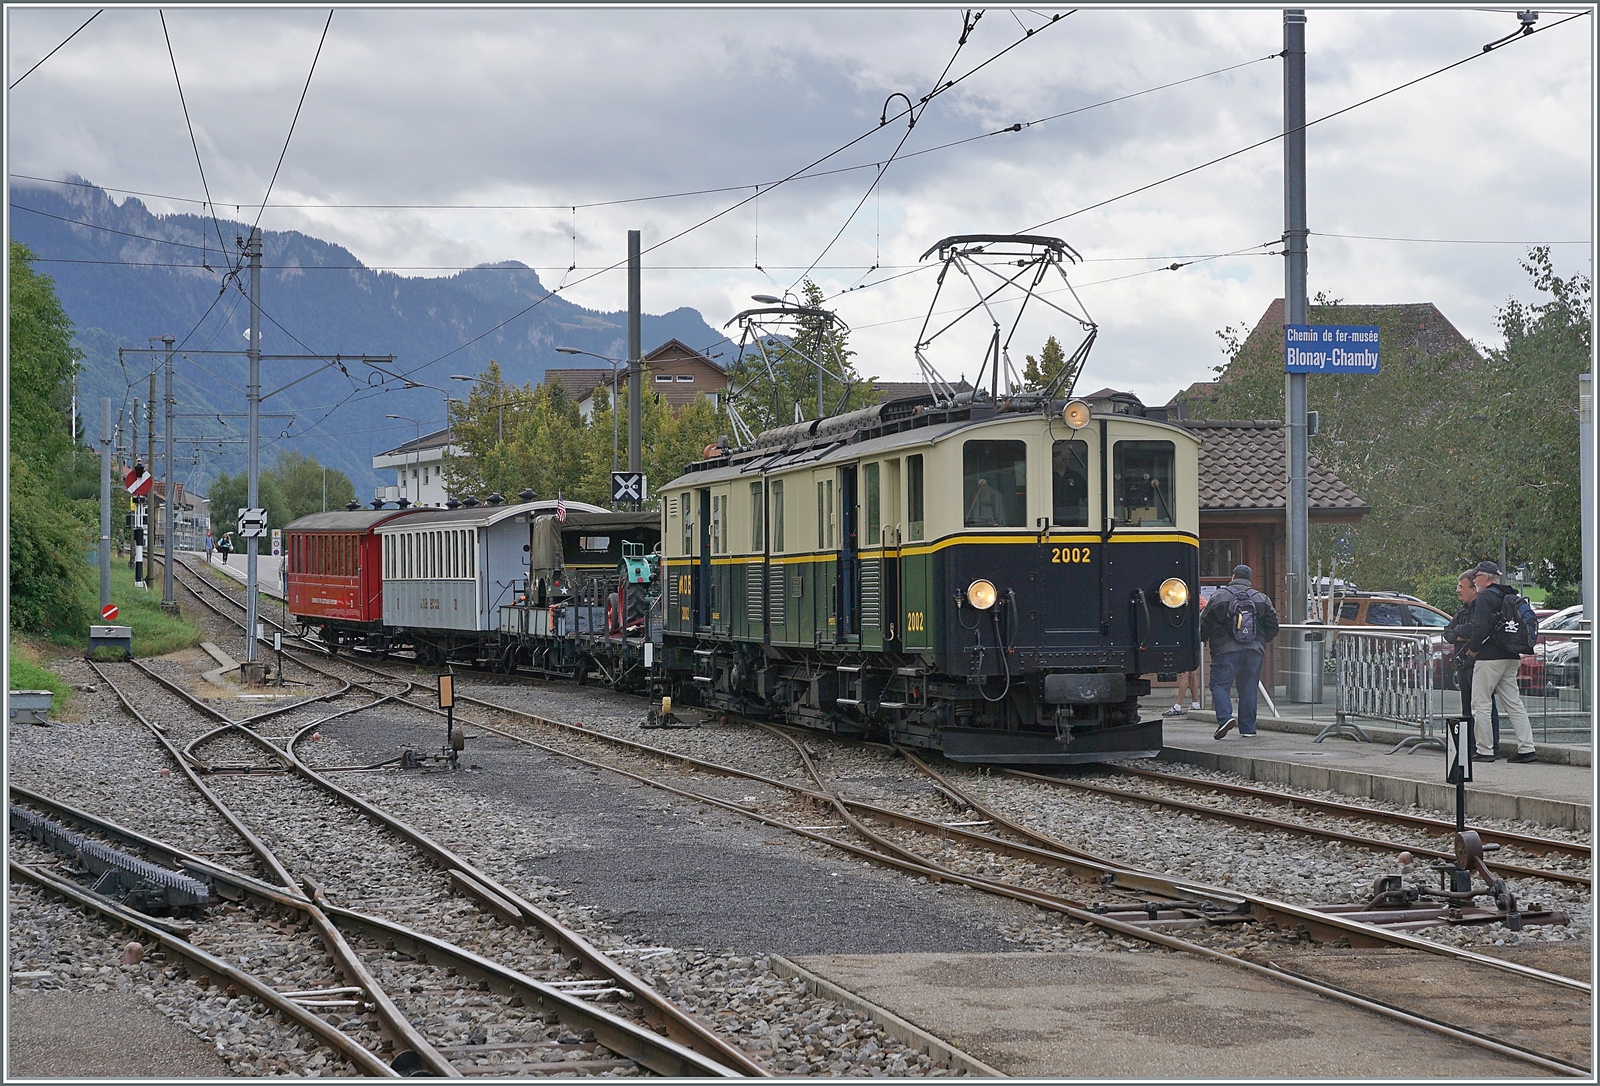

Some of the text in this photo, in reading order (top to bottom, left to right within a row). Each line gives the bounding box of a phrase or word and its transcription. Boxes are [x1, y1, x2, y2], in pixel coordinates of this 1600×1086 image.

[1287, 328, 1379, 343] Chemin de fer-musée
[1287, 347, 1378, 370] Blonay-Chamby
[1051, 547, 1091, 563] 2002
[907, 611, 924, 631] 2002
[1454, 724, 1459, 735] 6
